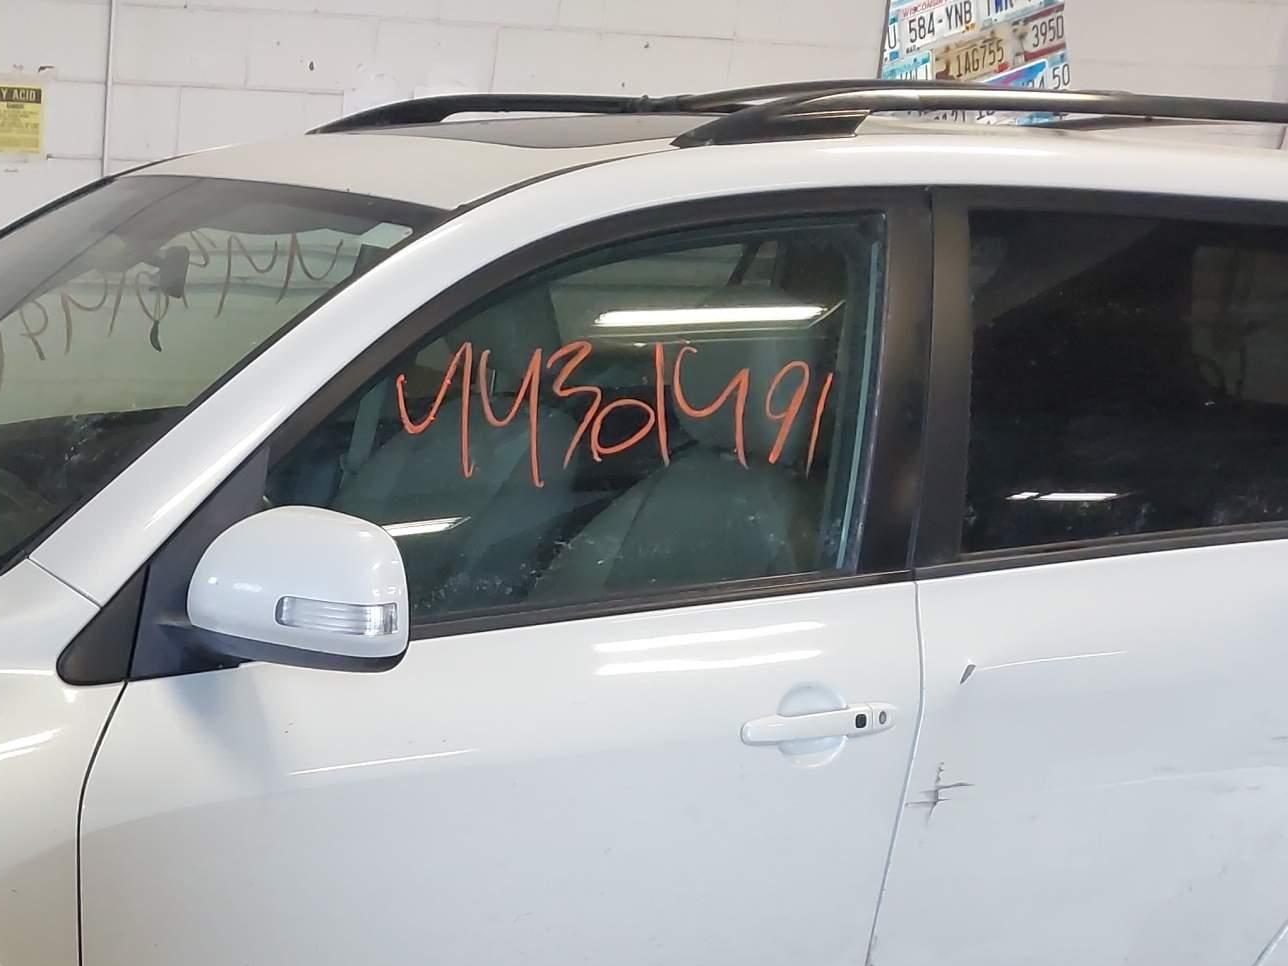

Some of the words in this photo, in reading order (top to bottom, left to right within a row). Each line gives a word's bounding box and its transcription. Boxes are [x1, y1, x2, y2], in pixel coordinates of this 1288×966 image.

[908, 1, 973, 43] 584-YNB
[12, 88, 36, 101] ACID
[396, 340, 834, 489] 44301491
